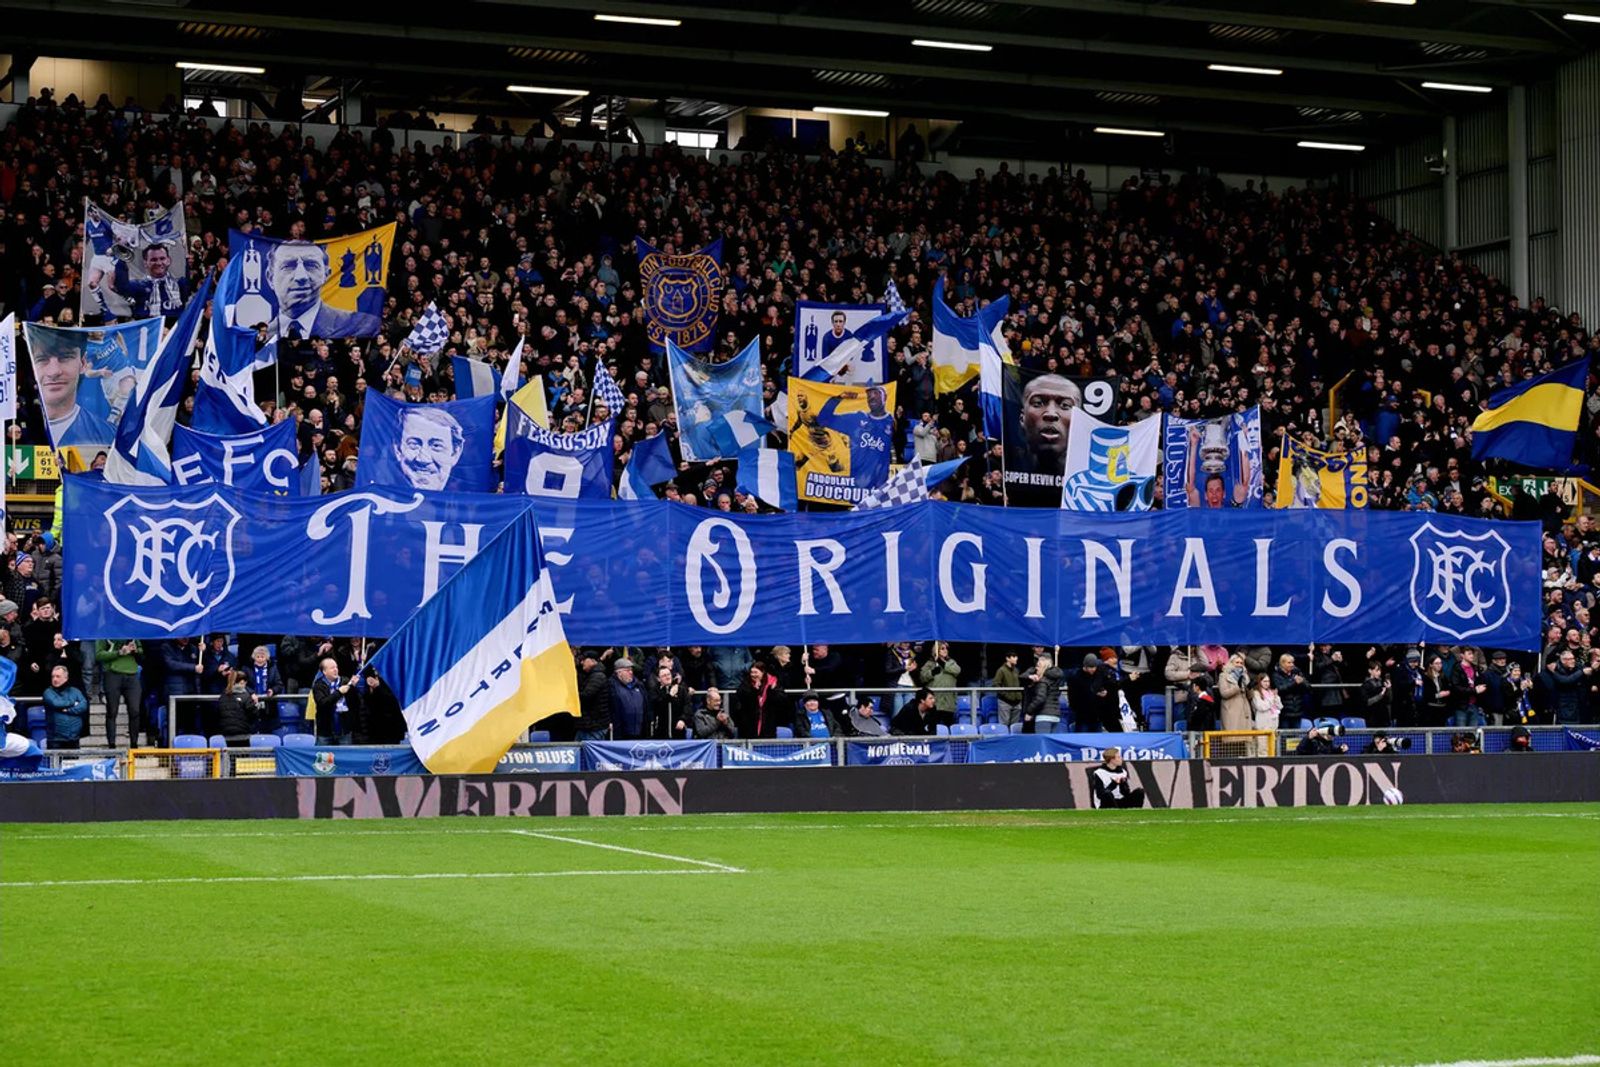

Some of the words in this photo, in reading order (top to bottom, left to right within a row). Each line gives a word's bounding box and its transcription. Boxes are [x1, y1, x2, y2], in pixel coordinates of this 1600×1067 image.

[708, 278, 721, 312] CLUB
[677, 321, 708, 346] 1878
[1083, 381, 1114, 415] 9
[516, 413, 611, 451] FERGUSON
[41, 458, 52, 466] 61
[41, 467, 52, 475] 75
[172, 434, 299, 487] EFC
[808, 473, 855, 487] ABDOULAYE
[1005, 470, 1029, 484] SUPER
[1030, 473, 1055, 487] KEVIN
[685, 518, 1362, 634] ORIGINALS
[535, 749, 576, 765] BLUES
